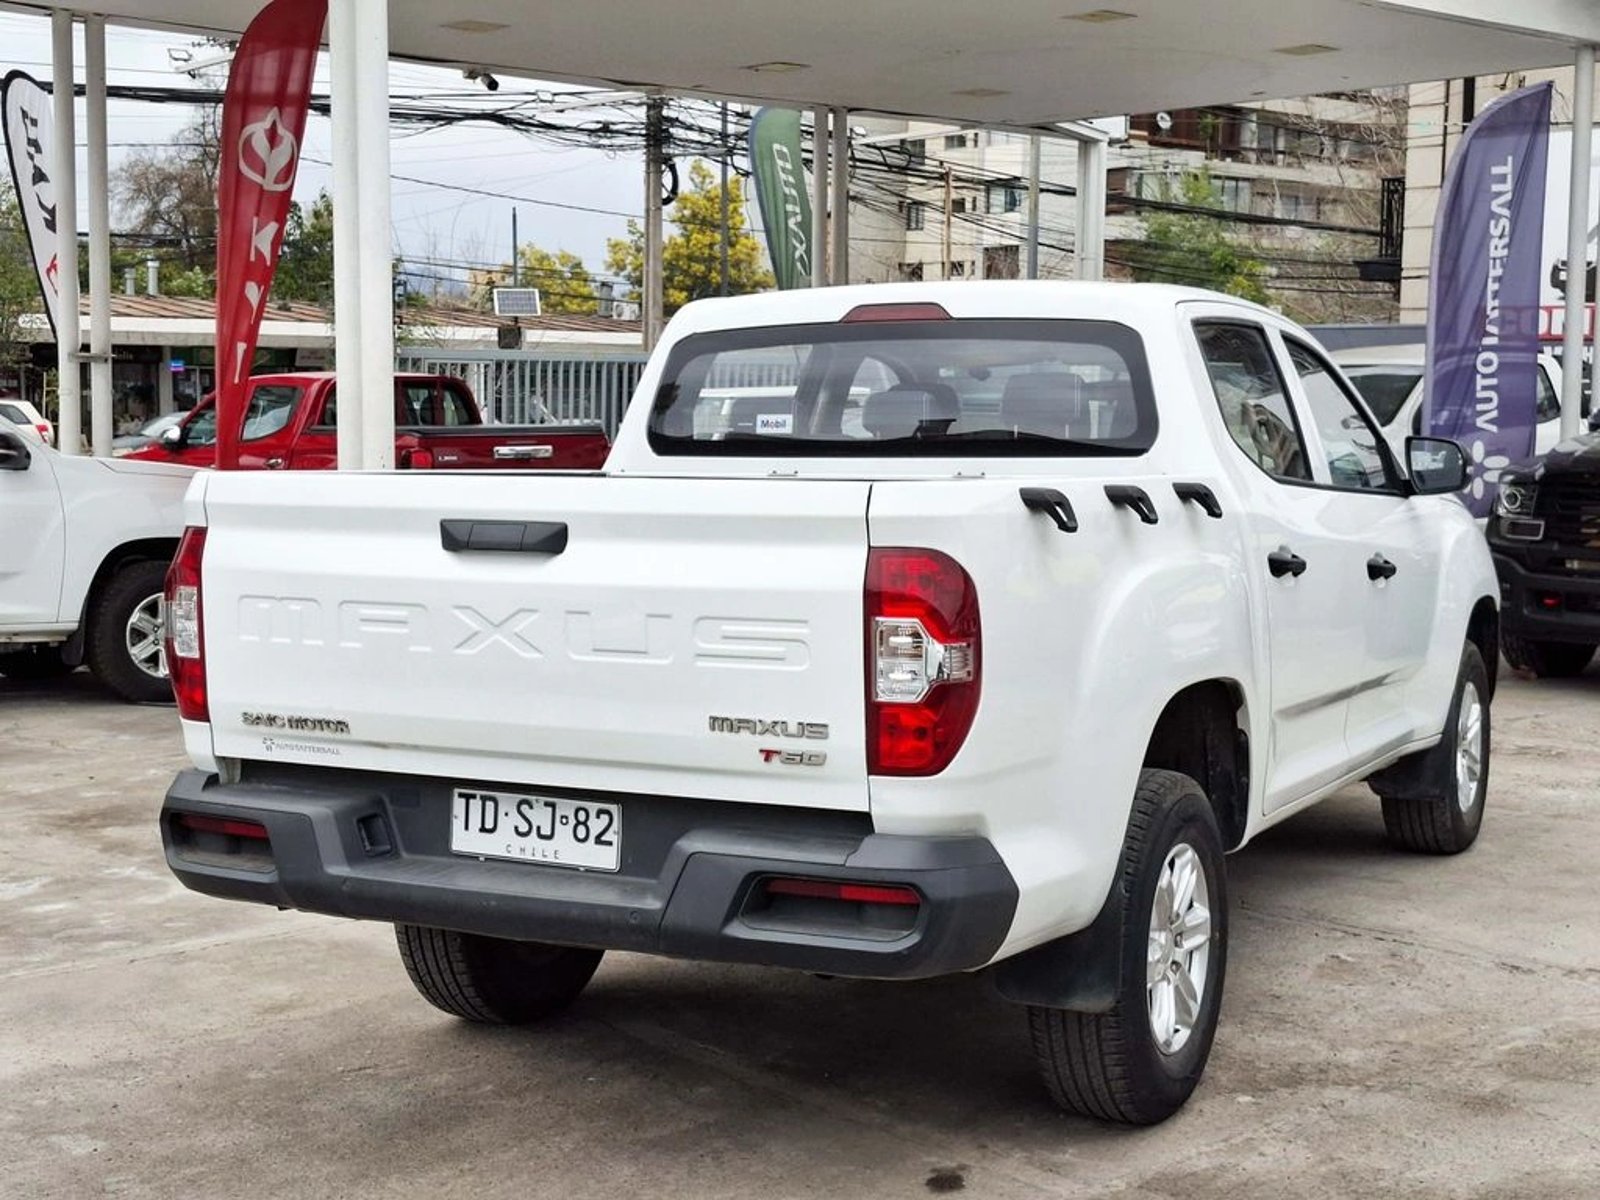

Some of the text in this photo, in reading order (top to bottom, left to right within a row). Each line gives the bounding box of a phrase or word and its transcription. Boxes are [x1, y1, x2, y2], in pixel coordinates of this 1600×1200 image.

[760, 419, 787, 429] Mobil
[237, 594, 812, 672] MAXUS
[241, 711, 351, 735] SAIC MOTOR
[708, 715, 829, 741] MAXUS
[758, 748, 827, 767] T60
[505, 843, 560, 860] CHILE
